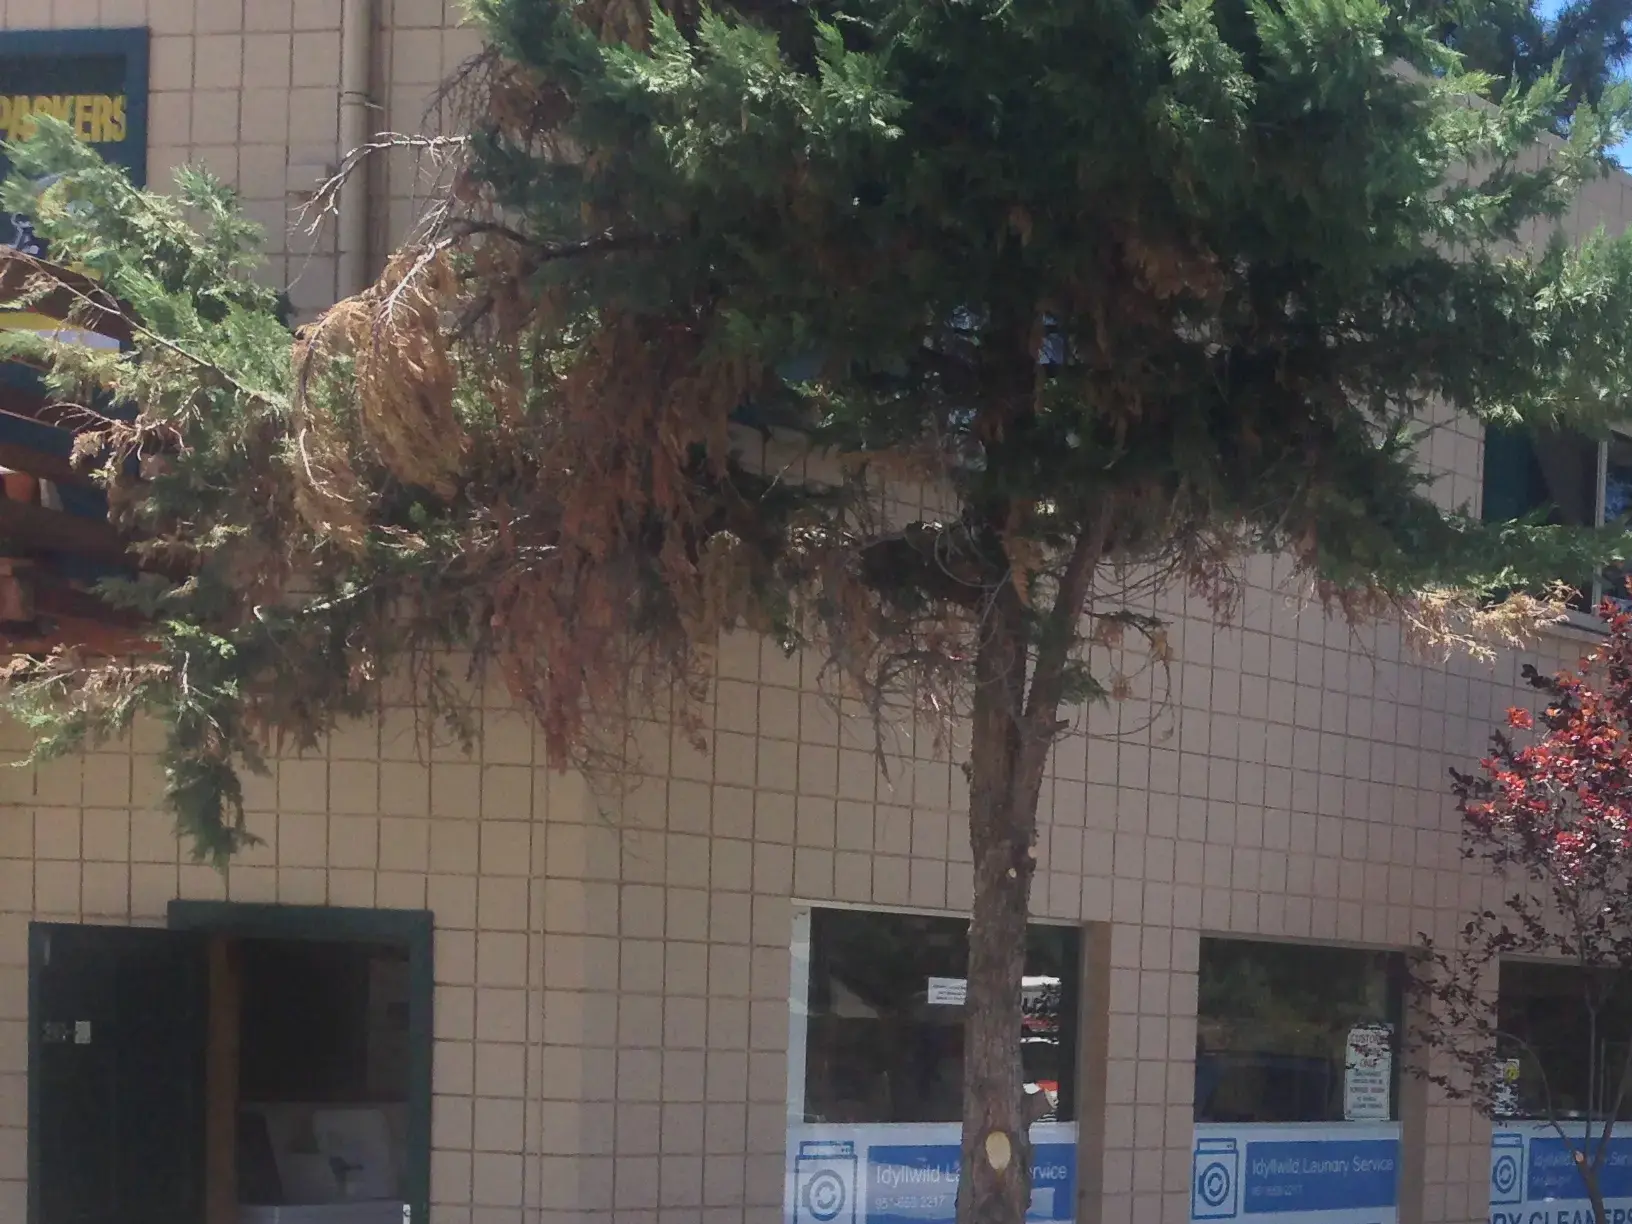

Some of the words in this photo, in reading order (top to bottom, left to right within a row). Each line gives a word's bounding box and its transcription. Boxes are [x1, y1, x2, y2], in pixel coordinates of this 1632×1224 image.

[876, 1164, 941, 1189] Idyllwild
[1030, 1162, 1067, 1181] rvice
[1252, 1156, 1300, 1179] Idyllwild
[1302, 1157, 1350, 1179] Laundry
[1352, 1154, 1394, 1173] Service
